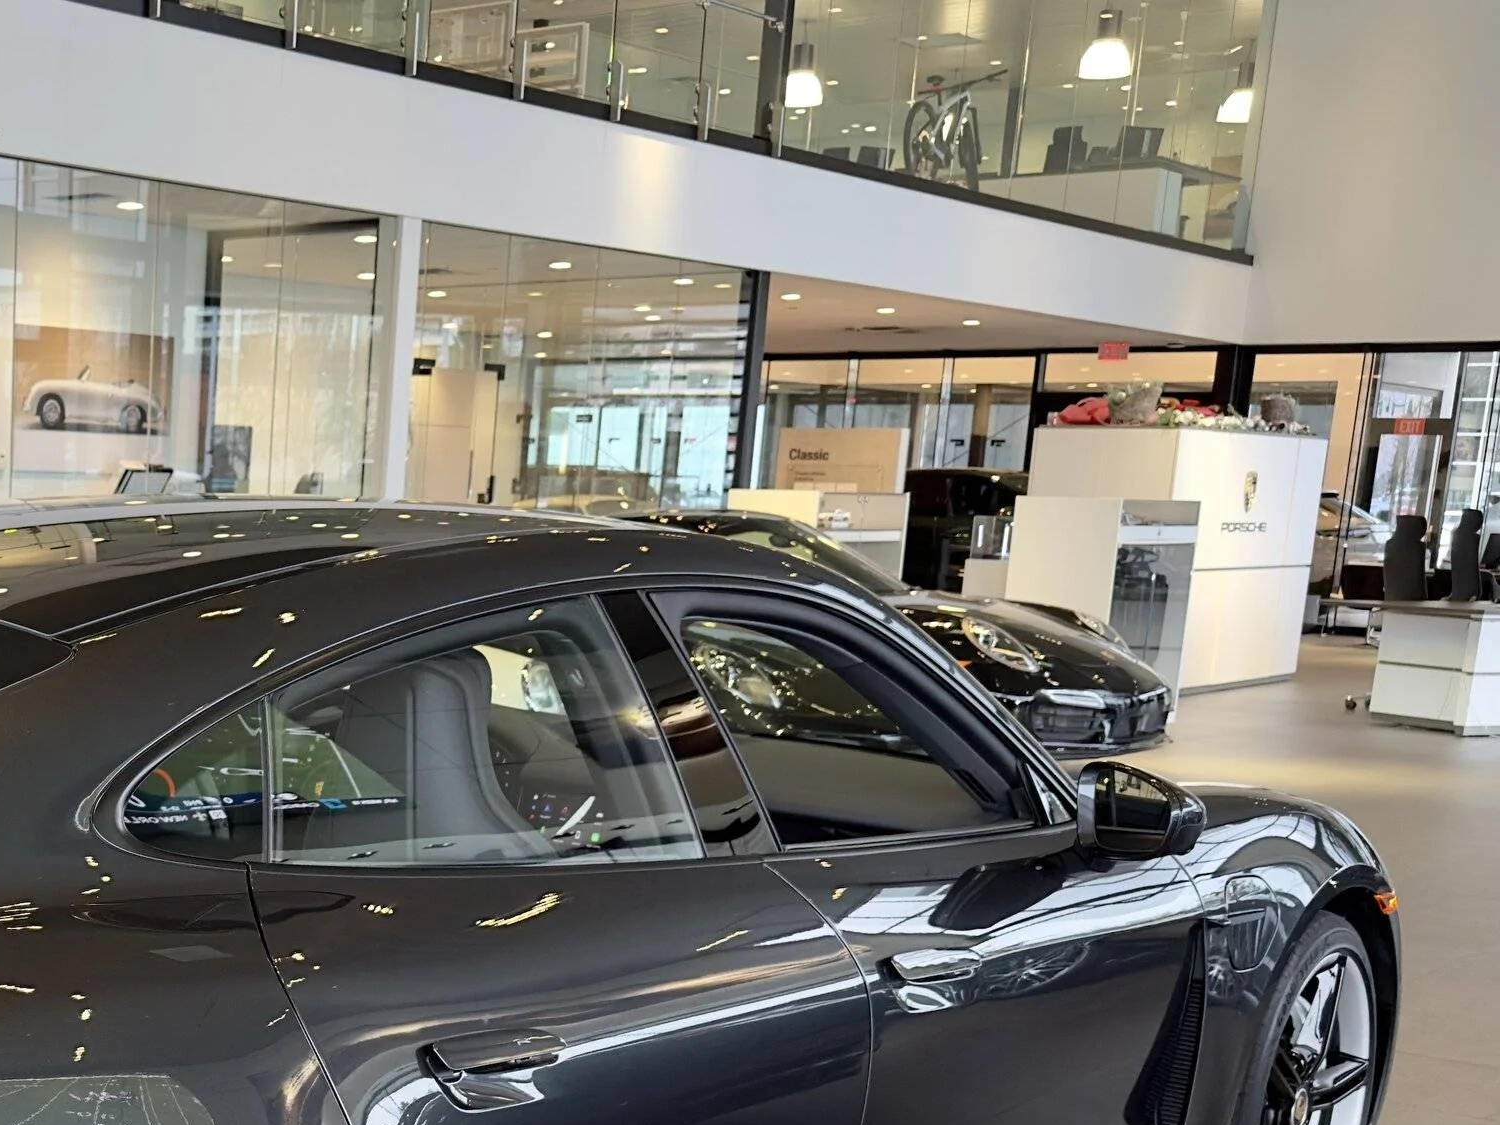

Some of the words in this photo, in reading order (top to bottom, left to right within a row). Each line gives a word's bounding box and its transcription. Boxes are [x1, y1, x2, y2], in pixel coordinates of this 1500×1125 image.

[1400, 421, 1423, 433] EXIT
[789, 448, 830, 461] Classic
[1221, 521, 1268, 533] PORSCHE
